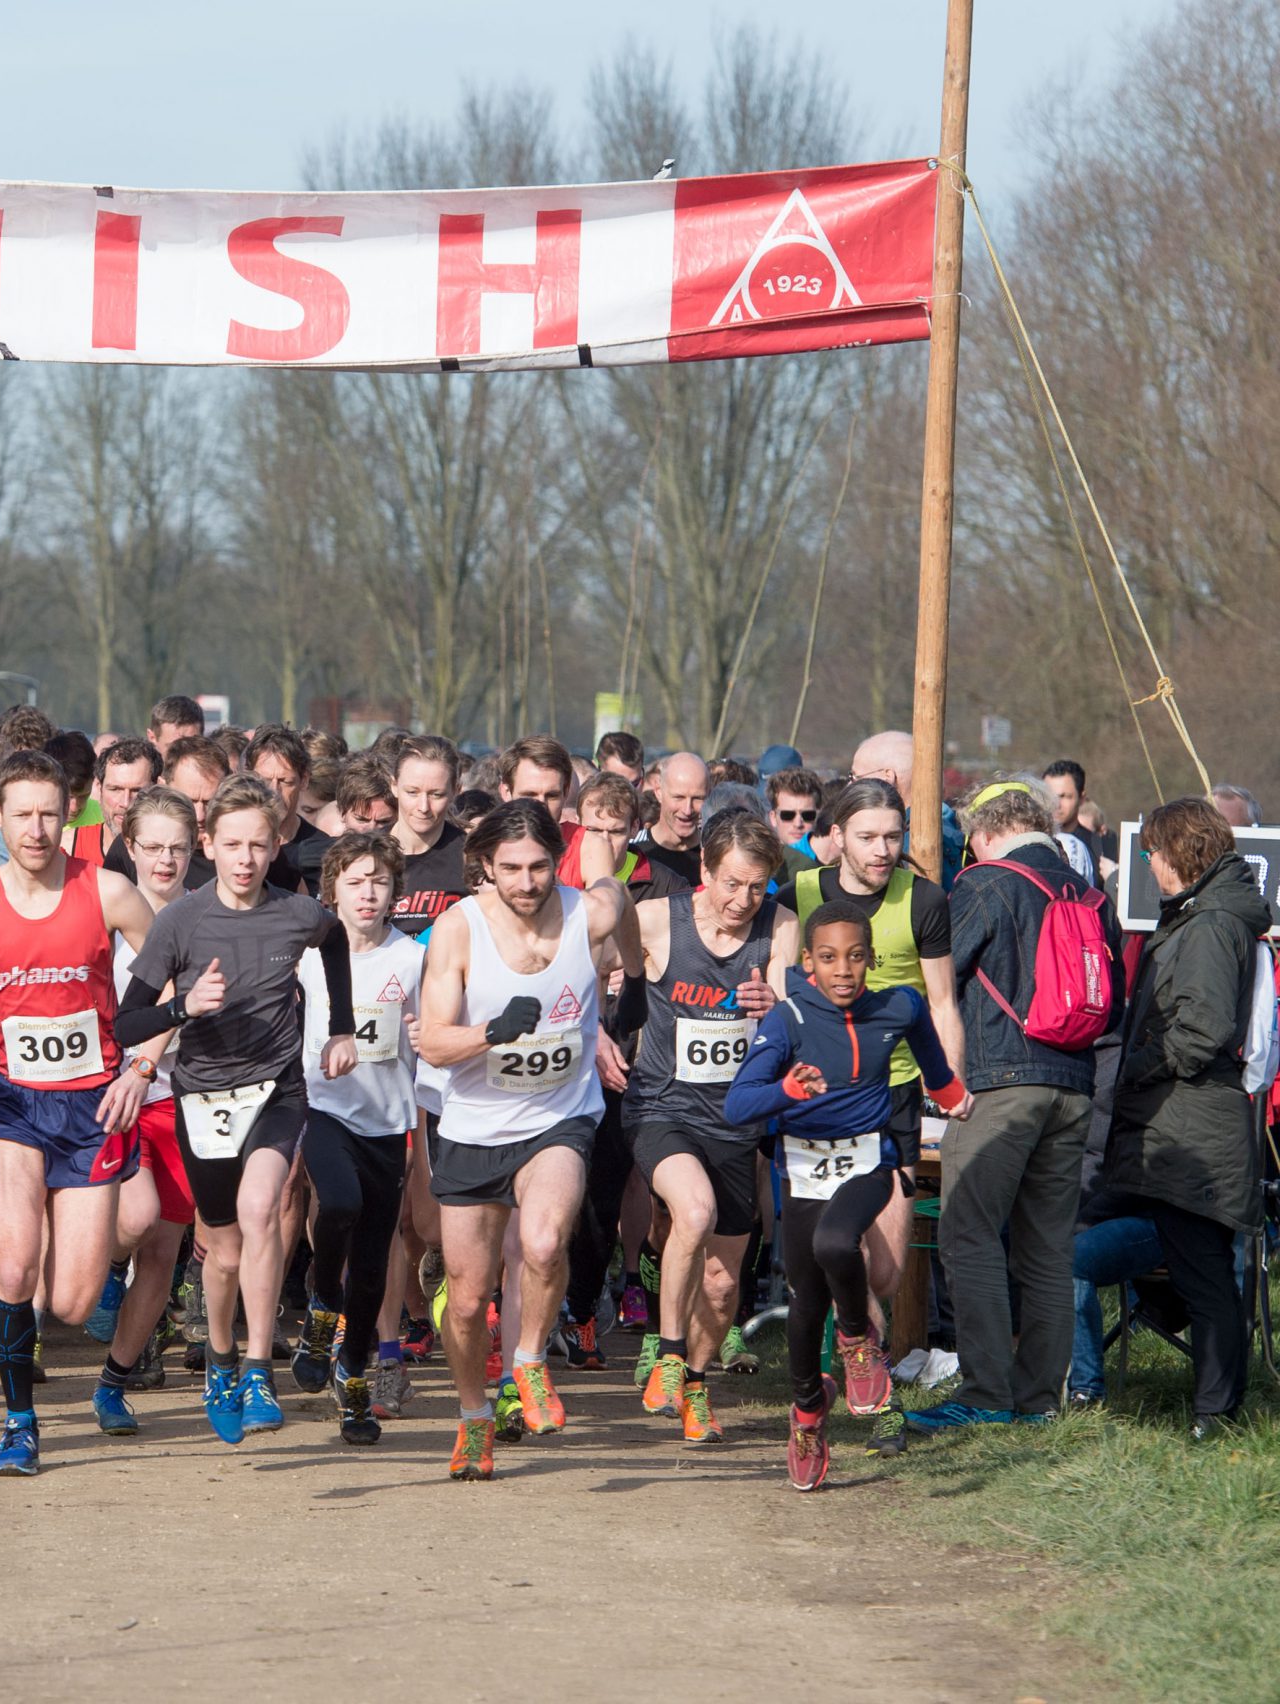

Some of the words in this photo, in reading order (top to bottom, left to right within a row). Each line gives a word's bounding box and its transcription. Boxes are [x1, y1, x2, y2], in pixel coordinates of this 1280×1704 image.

[763, 274, 823, 296] 1923
[18, 1021, 79, 1031] DiemerCross
[703, 1011, 736, 1020] HAARLEM
[691, 1025, 745, 1035] DiemerCross
[18, 1031, 88, 1062] 309
[687, 1038, 749, 1066] 669
[500, 1046, 572, 1077] 299
[809, 1155, 855, 1181] 45
